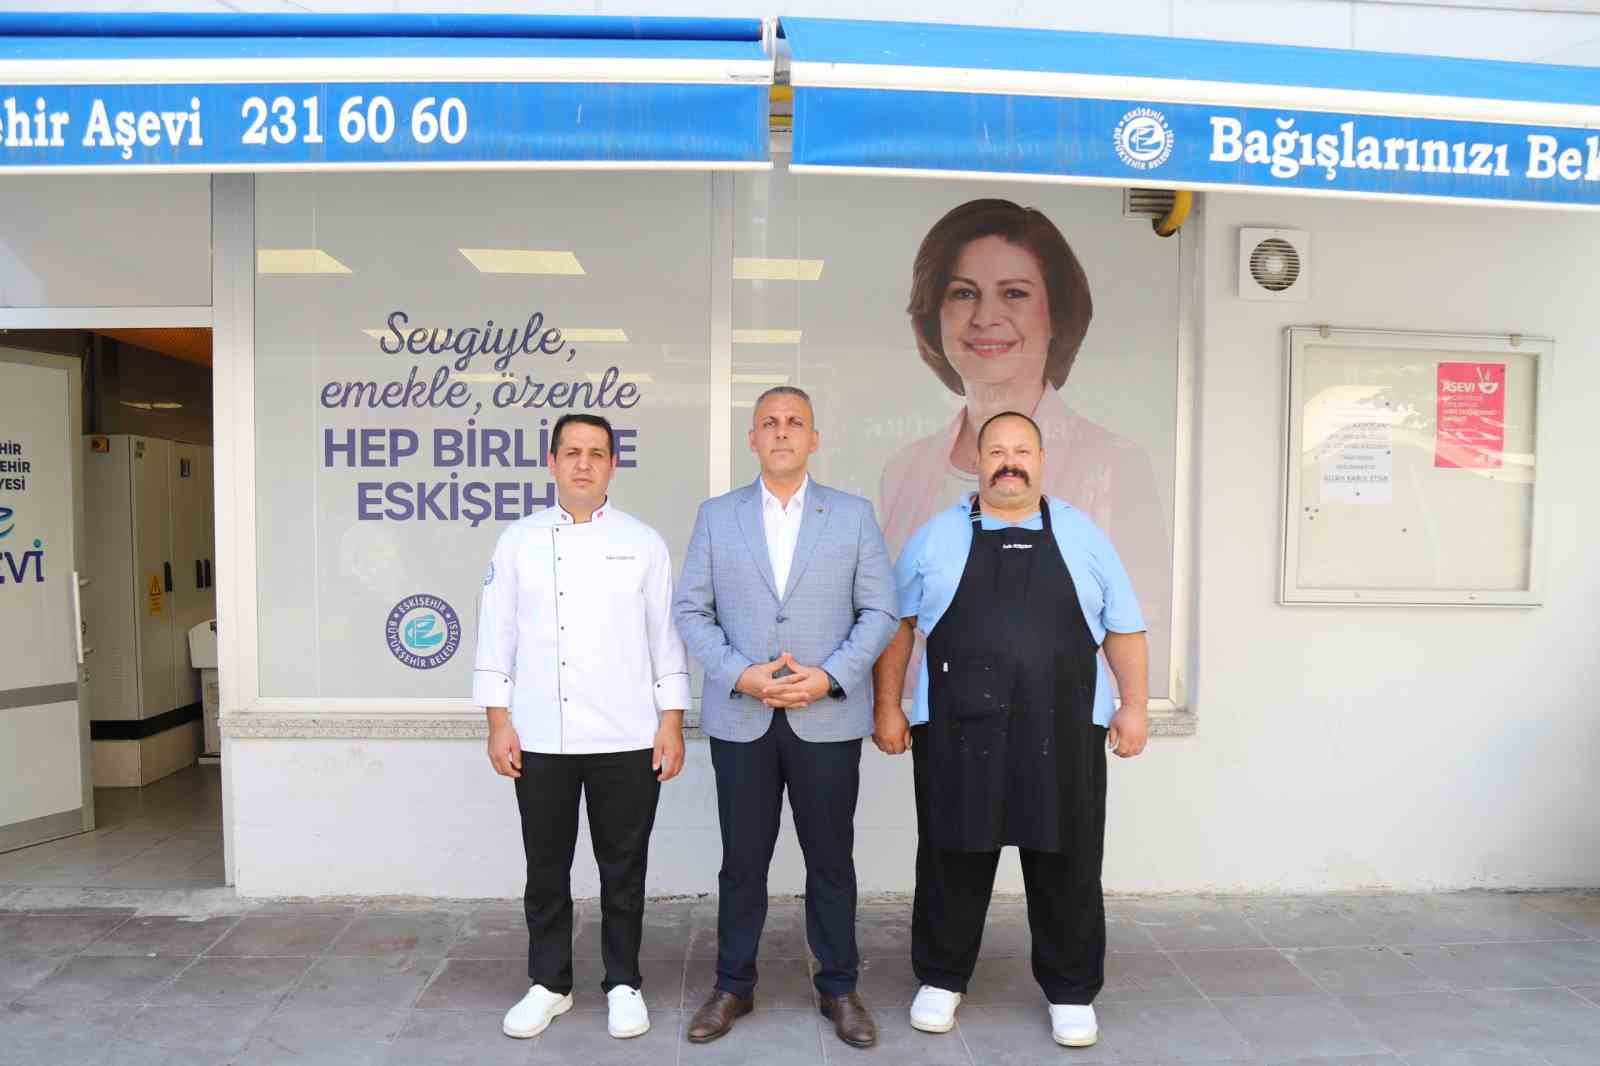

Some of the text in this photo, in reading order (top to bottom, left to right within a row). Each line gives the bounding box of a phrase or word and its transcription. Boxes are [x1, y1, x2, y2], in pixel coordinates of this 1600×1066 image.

[0, 95, 468, 160] hir Aşevi 231 60 60
[1209, 115, 1510, 182] Bağışlarınızı
[380, 311, 577, 372] Sevgiyle,
[320, 366, 641, 416] emekle, özenle
[324, 418, 638, 468] HEP BİRLİE
[357, 471, 557, 528] ESKİŞEH
[0, 538, 44, 584] Vİ
[397, 596, 447, 614] ESKİŞEHİR
